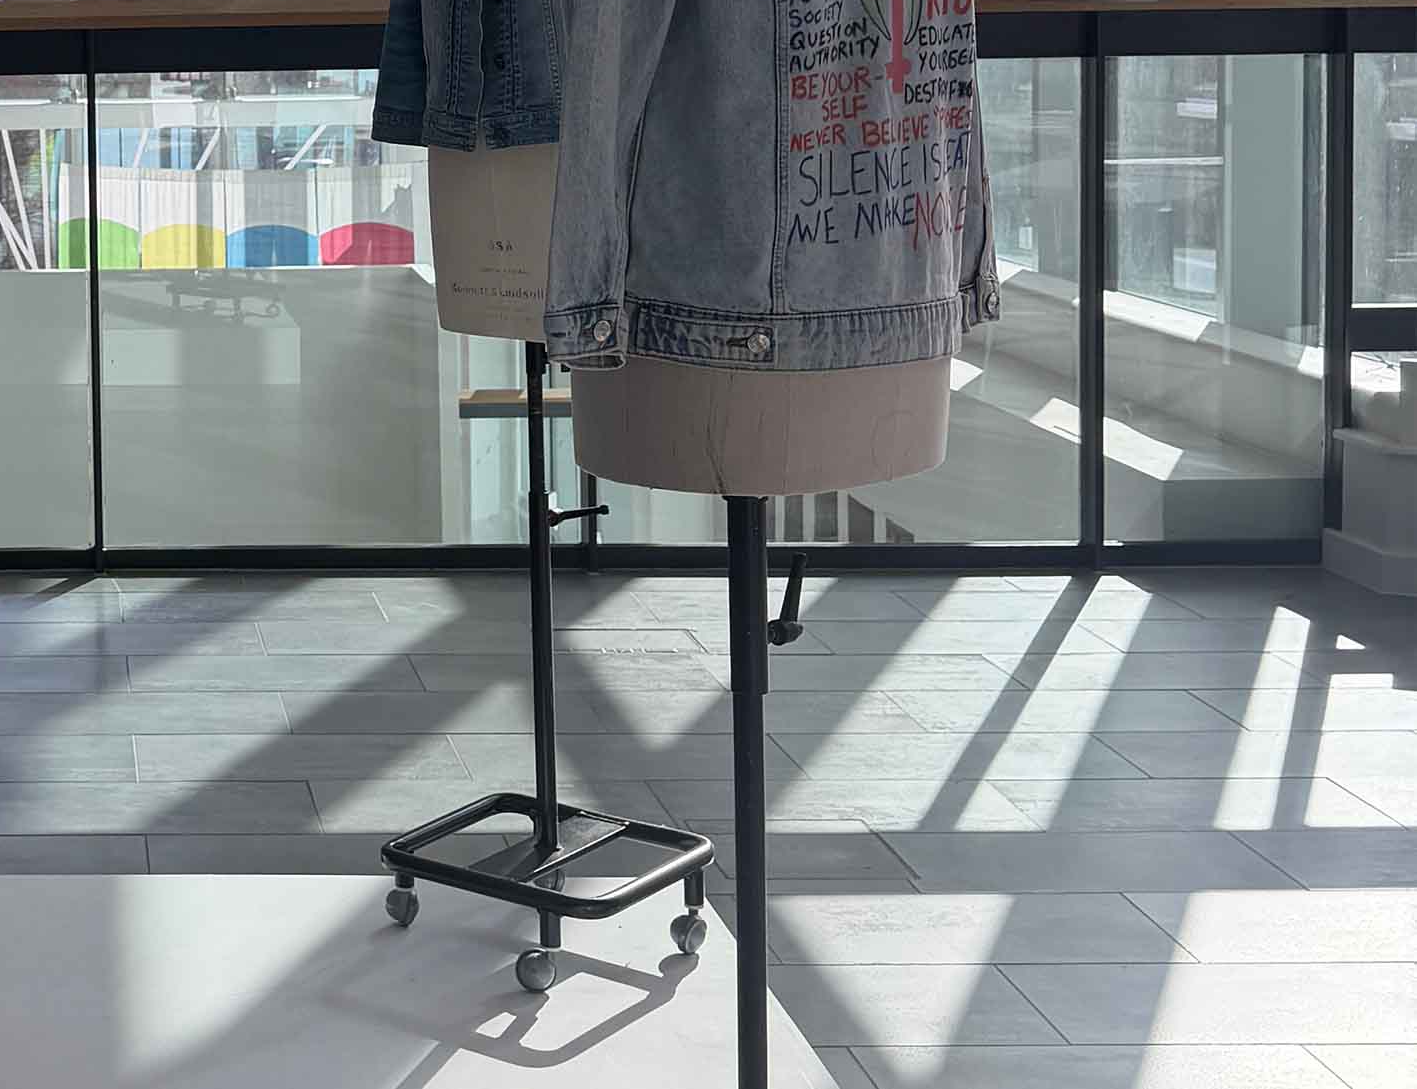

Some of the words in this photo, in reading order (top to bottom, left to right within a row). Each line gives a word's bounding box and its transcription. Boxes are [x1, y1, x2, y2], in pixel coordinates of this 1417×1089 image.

[789, 0, 844, 29] SOCIETY
[790, 17, 868, 51] QUESTION
[789, 35, 880, 73] AUTHORITY
[790, 73, 820, 101] BE
[821, 94, 869, 123] SELF
[790, 123, 848, 153] NEVER
[860, 113, 931, 148] BELIEVE
[798, 144, 913, 207] SILENCE
[922, 138, 942, 185] IS
[787, 206, 840, 246] WE
[853, 193, 915, 240] MAKE
